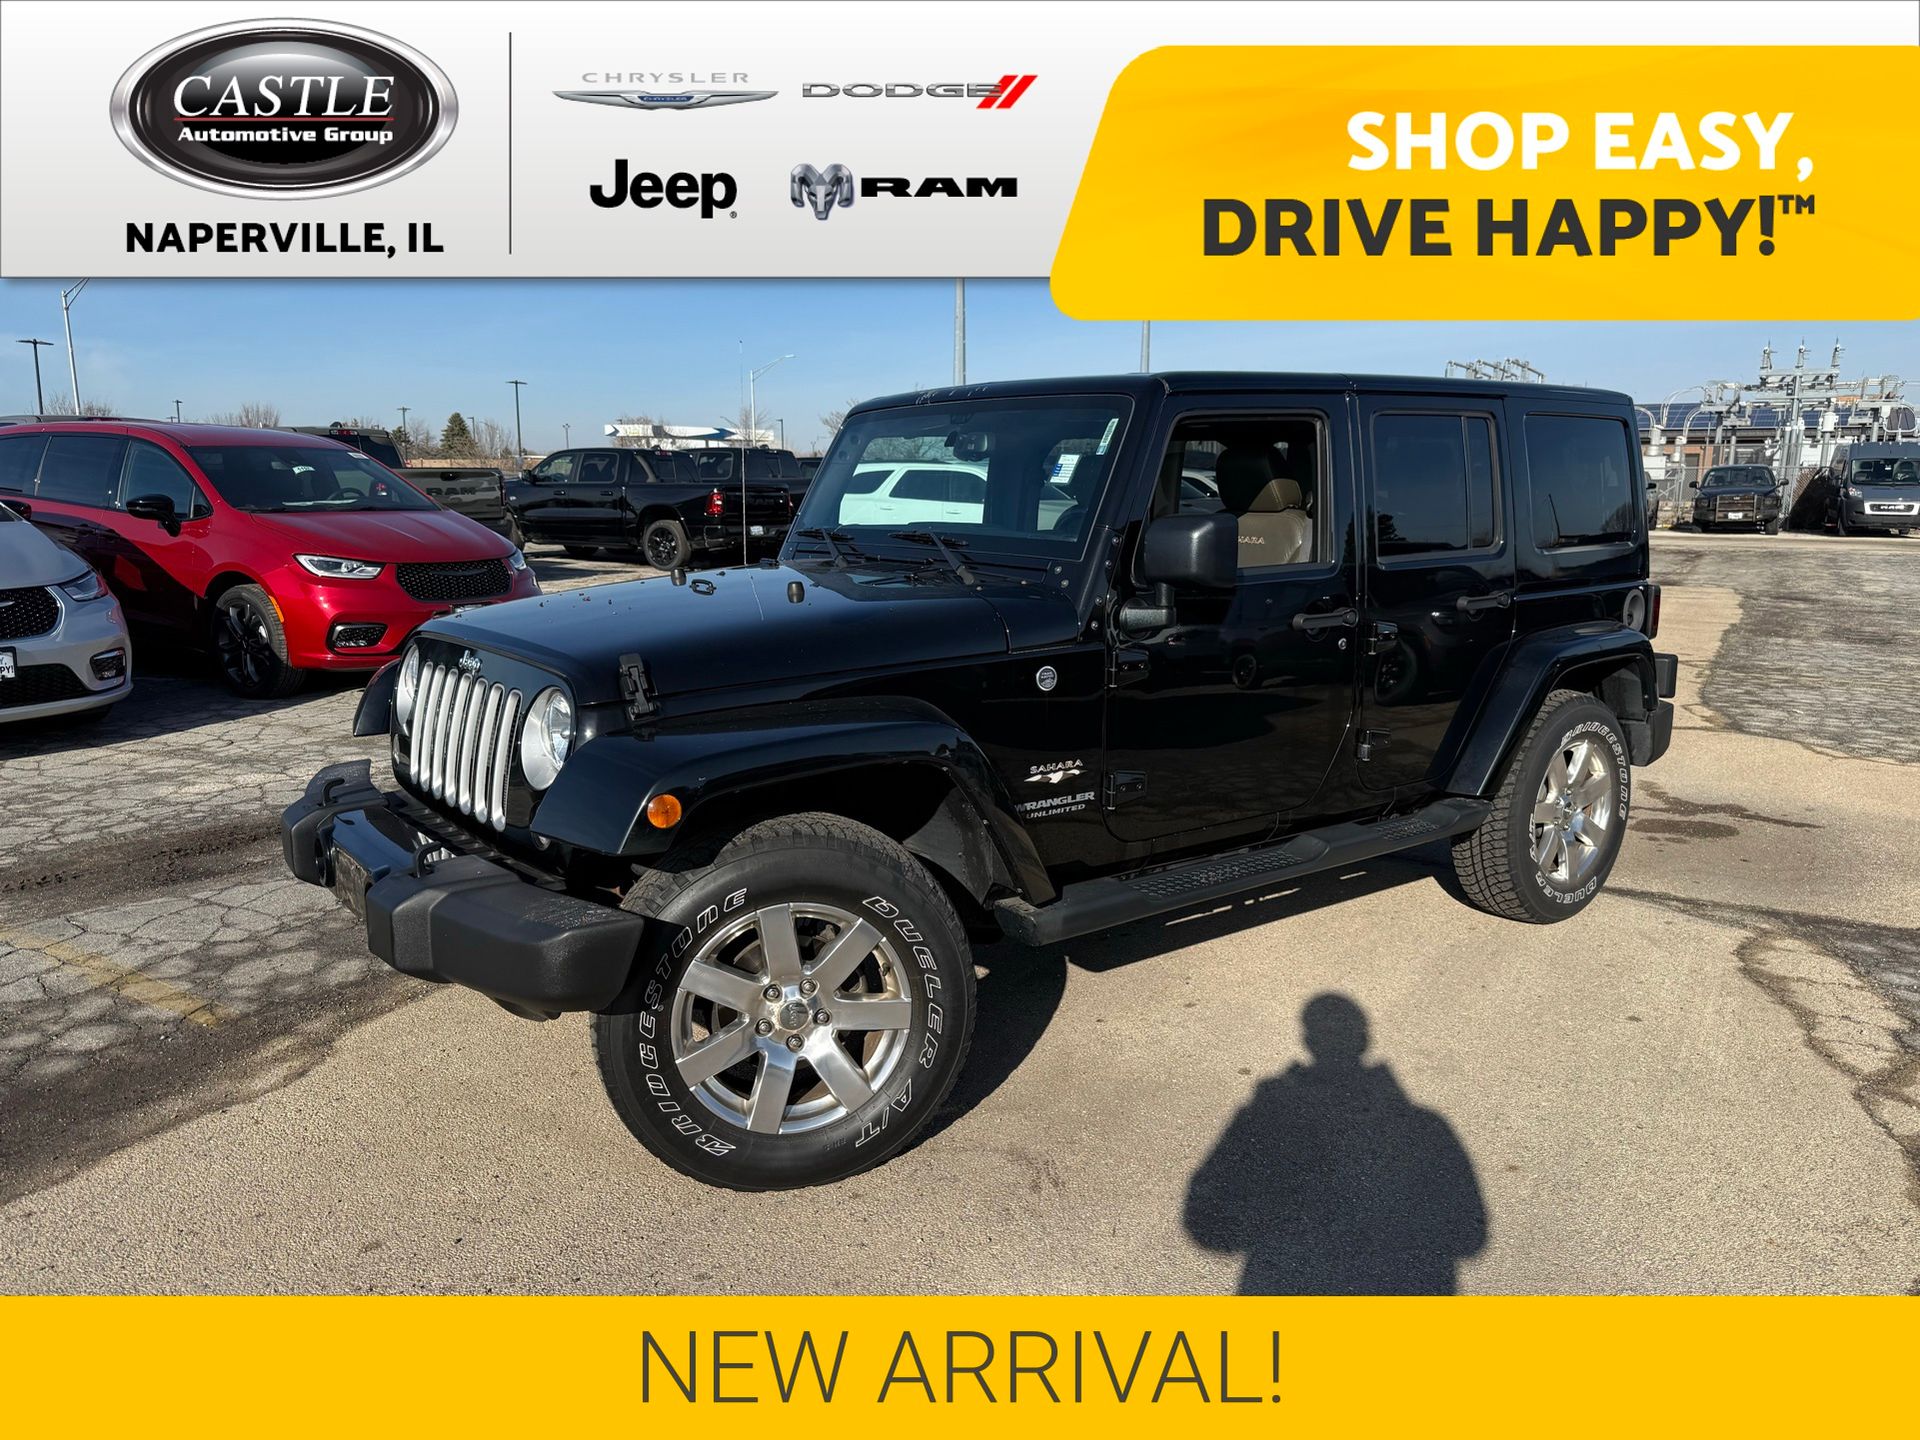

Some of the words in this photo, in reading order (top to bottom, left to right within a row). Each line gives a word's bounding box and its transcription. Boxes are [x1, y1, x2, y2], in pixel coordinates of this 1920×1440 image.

[426, 487, 476, 496] RAM
[459, 649, 481, 676] Jeep
[1030, 759, 1083, 774] SAHARA
[1561, 721, 1629, 821] BRIDGESTONE
[1014, 791, 1095, 812] WRANGLER
[1026, 803, 1086, 819] UNLIMITED
[1535, 871, 1598, 904] DUELER
[862, 895, 944, 1069] DUELER
[638, 887, 748, 1157] BRIDGESTONE
[855, 1077, 912, 1148] A/T
